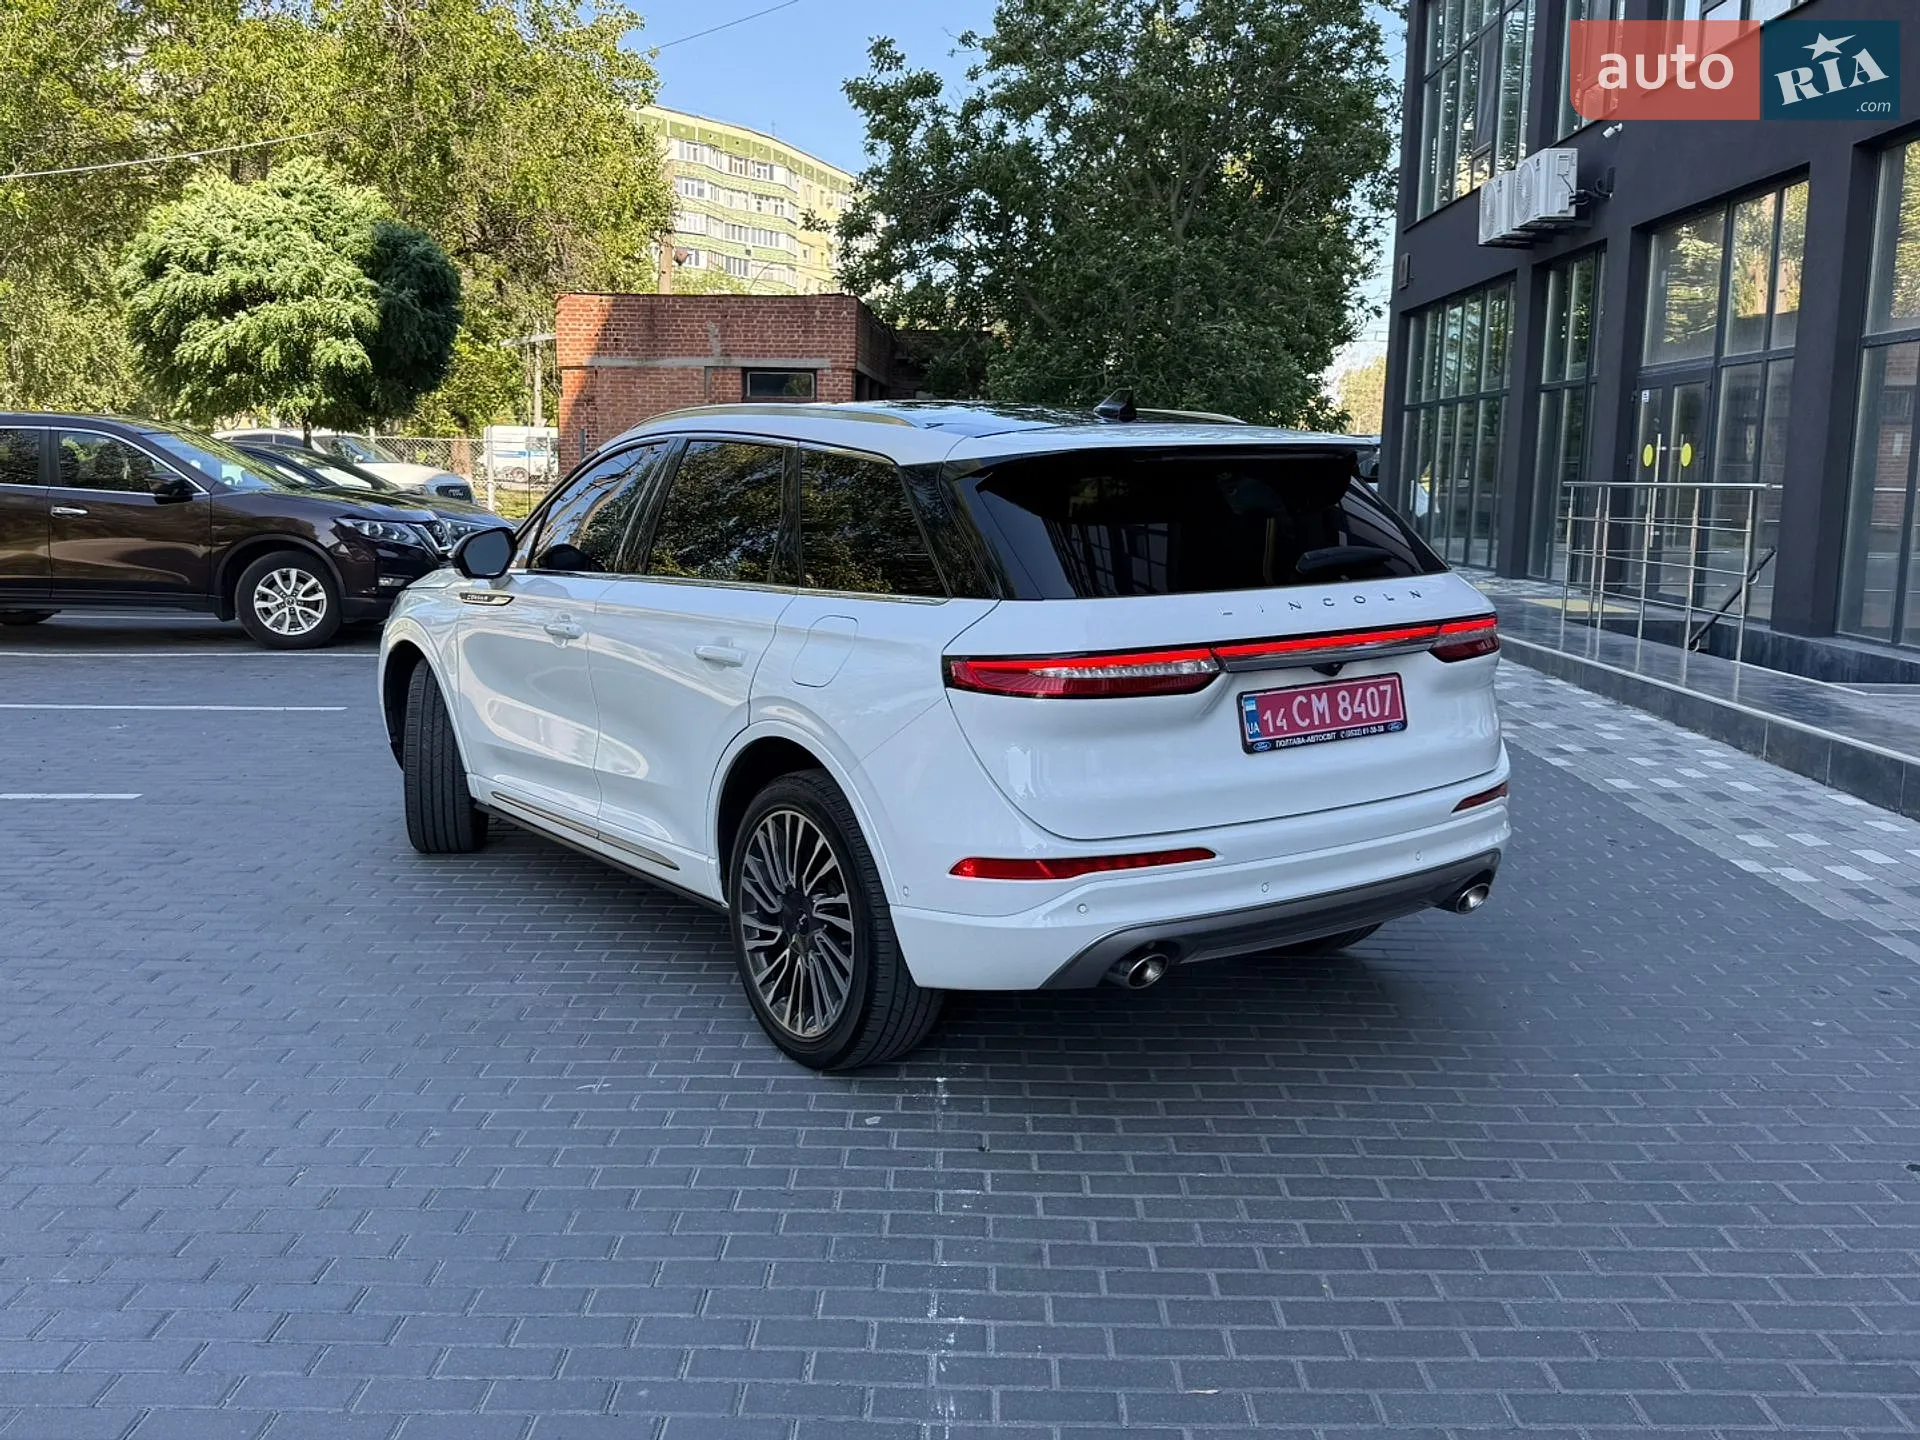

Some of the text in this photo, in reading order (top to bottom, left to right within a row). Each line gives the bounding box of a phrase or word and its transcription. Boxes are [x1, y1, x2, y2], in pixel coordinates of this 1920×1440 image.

[1263, 684, 1393, 733] 14 CM 8407
[1247, 721, 1261, 735] UA
